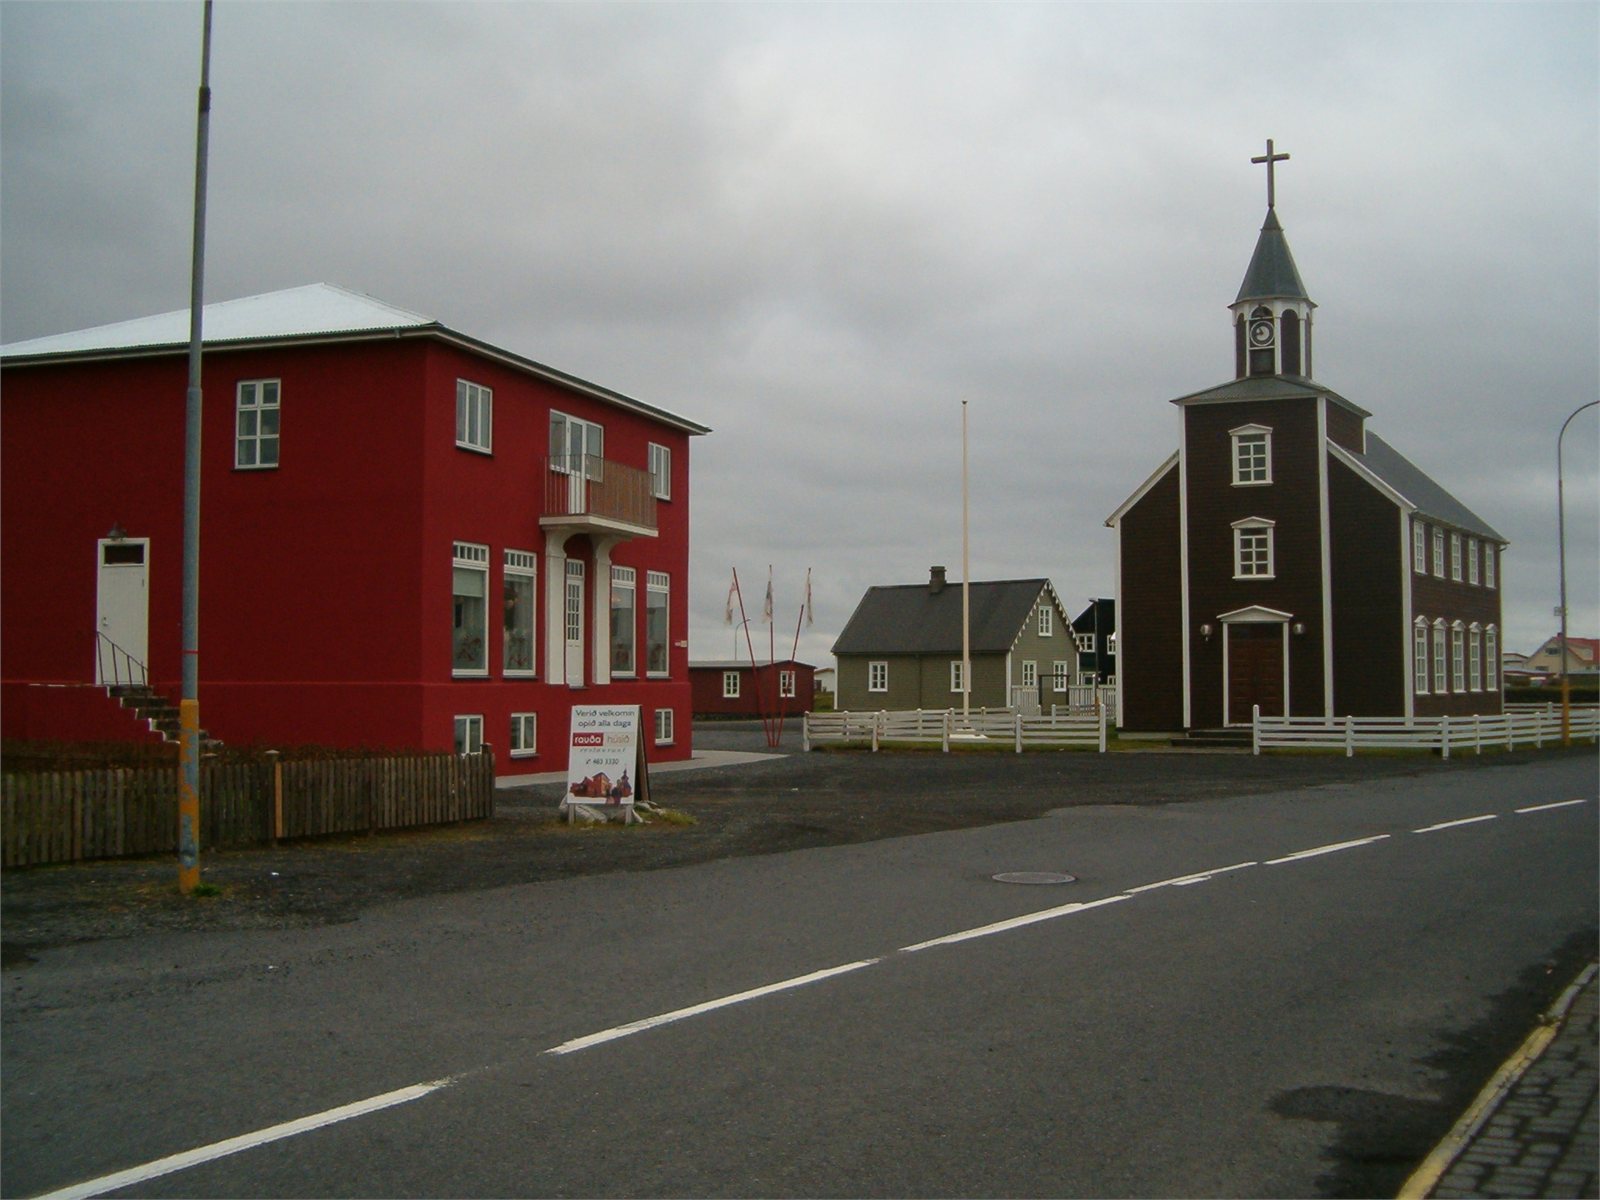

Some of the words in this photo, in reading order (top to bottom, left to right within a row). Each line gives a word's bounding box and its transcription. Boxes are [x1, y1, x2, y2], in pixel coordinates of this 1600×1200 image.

[578, 719, 596, 728] opið
[598, 719, 611, 727] alla
[613, 719, 631, 728] daga
